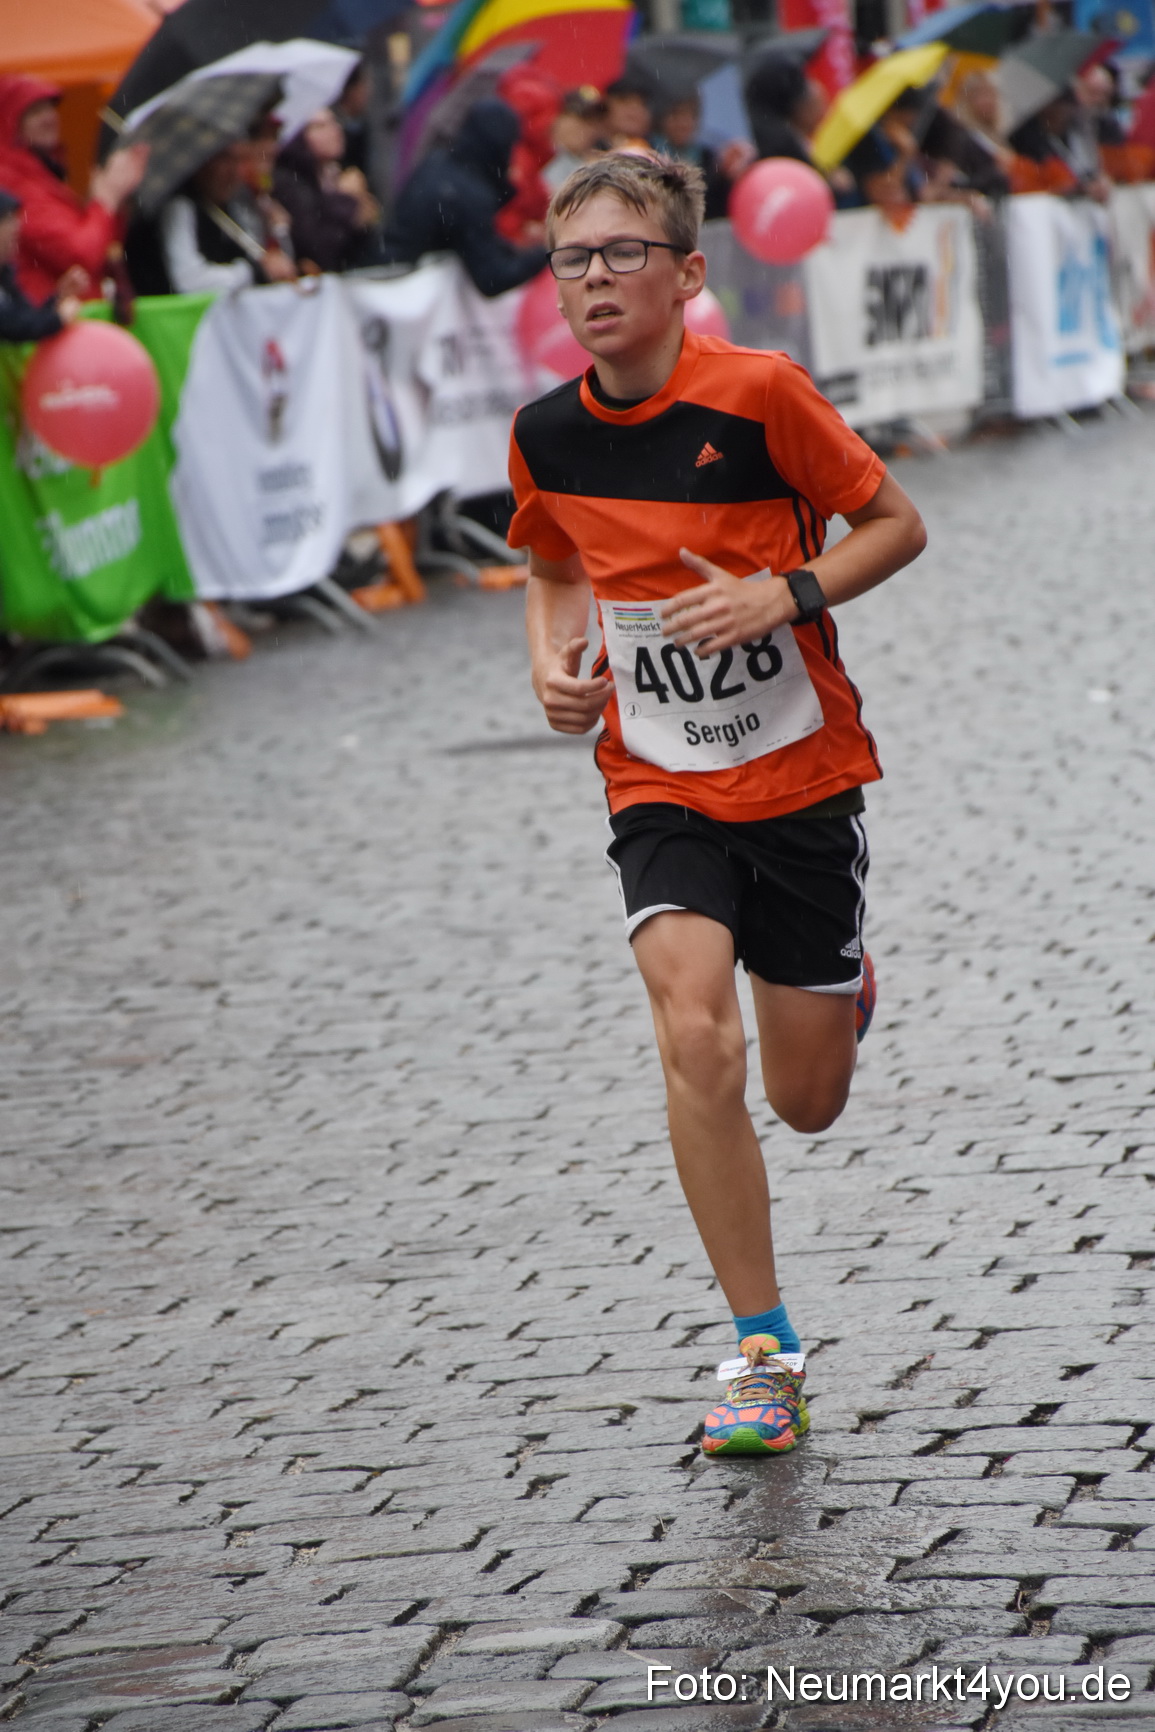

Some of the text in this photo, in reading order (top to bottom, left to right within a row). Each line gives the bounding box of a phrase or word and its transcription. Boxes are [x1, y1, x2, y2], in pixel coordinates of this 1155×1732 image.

[695, 452, 724, 468] adidas
[635, 633, 783, 704] 4028
[683, 712, 761, 747] Sergio
